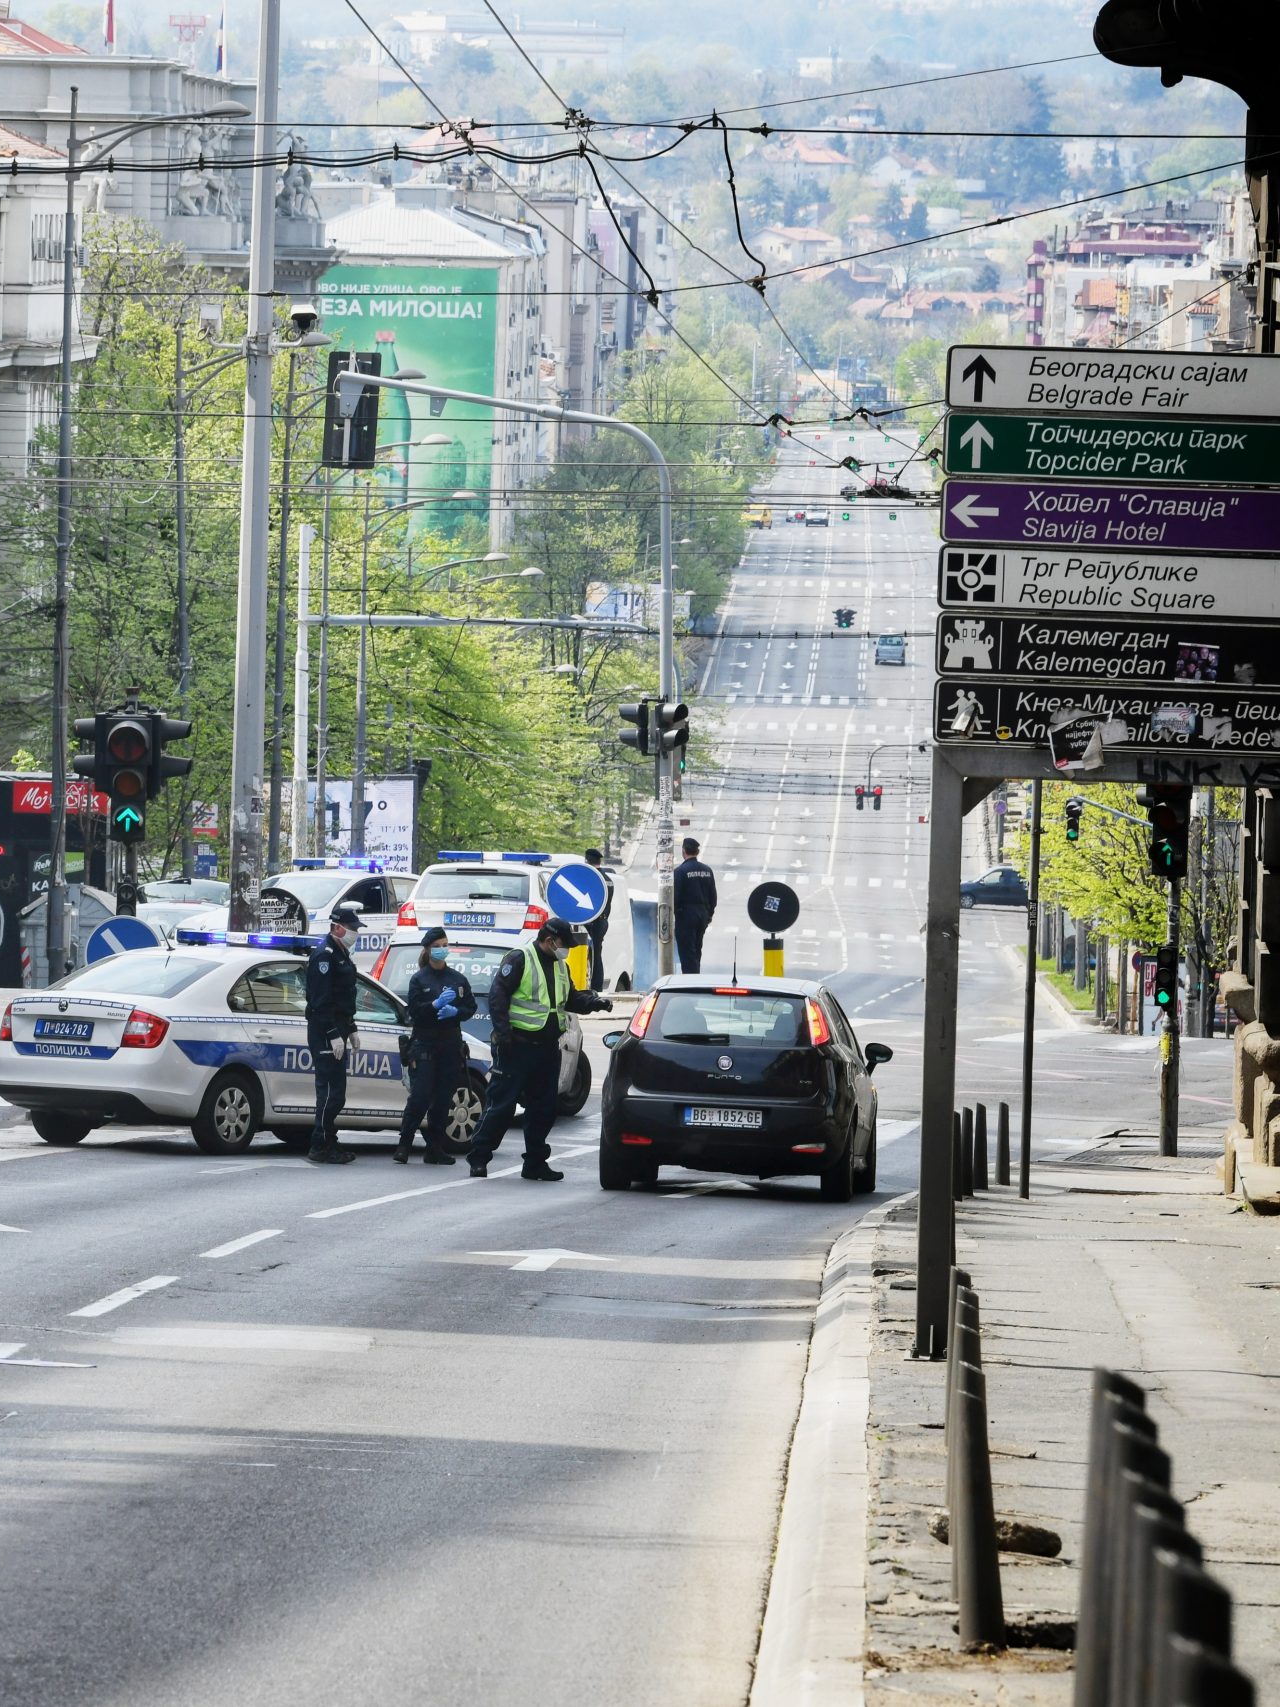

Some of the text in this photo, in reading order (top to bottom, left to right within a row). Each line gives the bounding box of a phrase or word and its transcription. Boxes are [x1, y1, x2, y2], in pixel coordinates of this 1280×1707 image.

[341, 284, 370, 293] НИЈЕ
[320, 298, 483, 319] ЕЗА МИЛОША!
[1028, 356, 1248, 387] Београдски сајам
[1027, 383, 1189, 409] Belgrade Fair
[1026, 449, 1187, 475] Topcider Park
[1119, 493, 1239, 521] "Славија"
[1022, 518, 1166, 542] Slavija Hotel
[1020, 556, 1059, 582] Трг
[1019, 583, 1215, 613] Republic Square
[1017, 624, 1170, 651] Калемегдан
[1016, 651, 1166, 678] Kalemegdan
[20, 787, 49, 809] Moj
[392, 843, 409, 852] 39%
[35, 1043, 92, 1057] ПОЛИЦИЈА
[283, 1047, 392, 1077] ПОЦИЈА
[693, 1109, 707, 1121] BG
